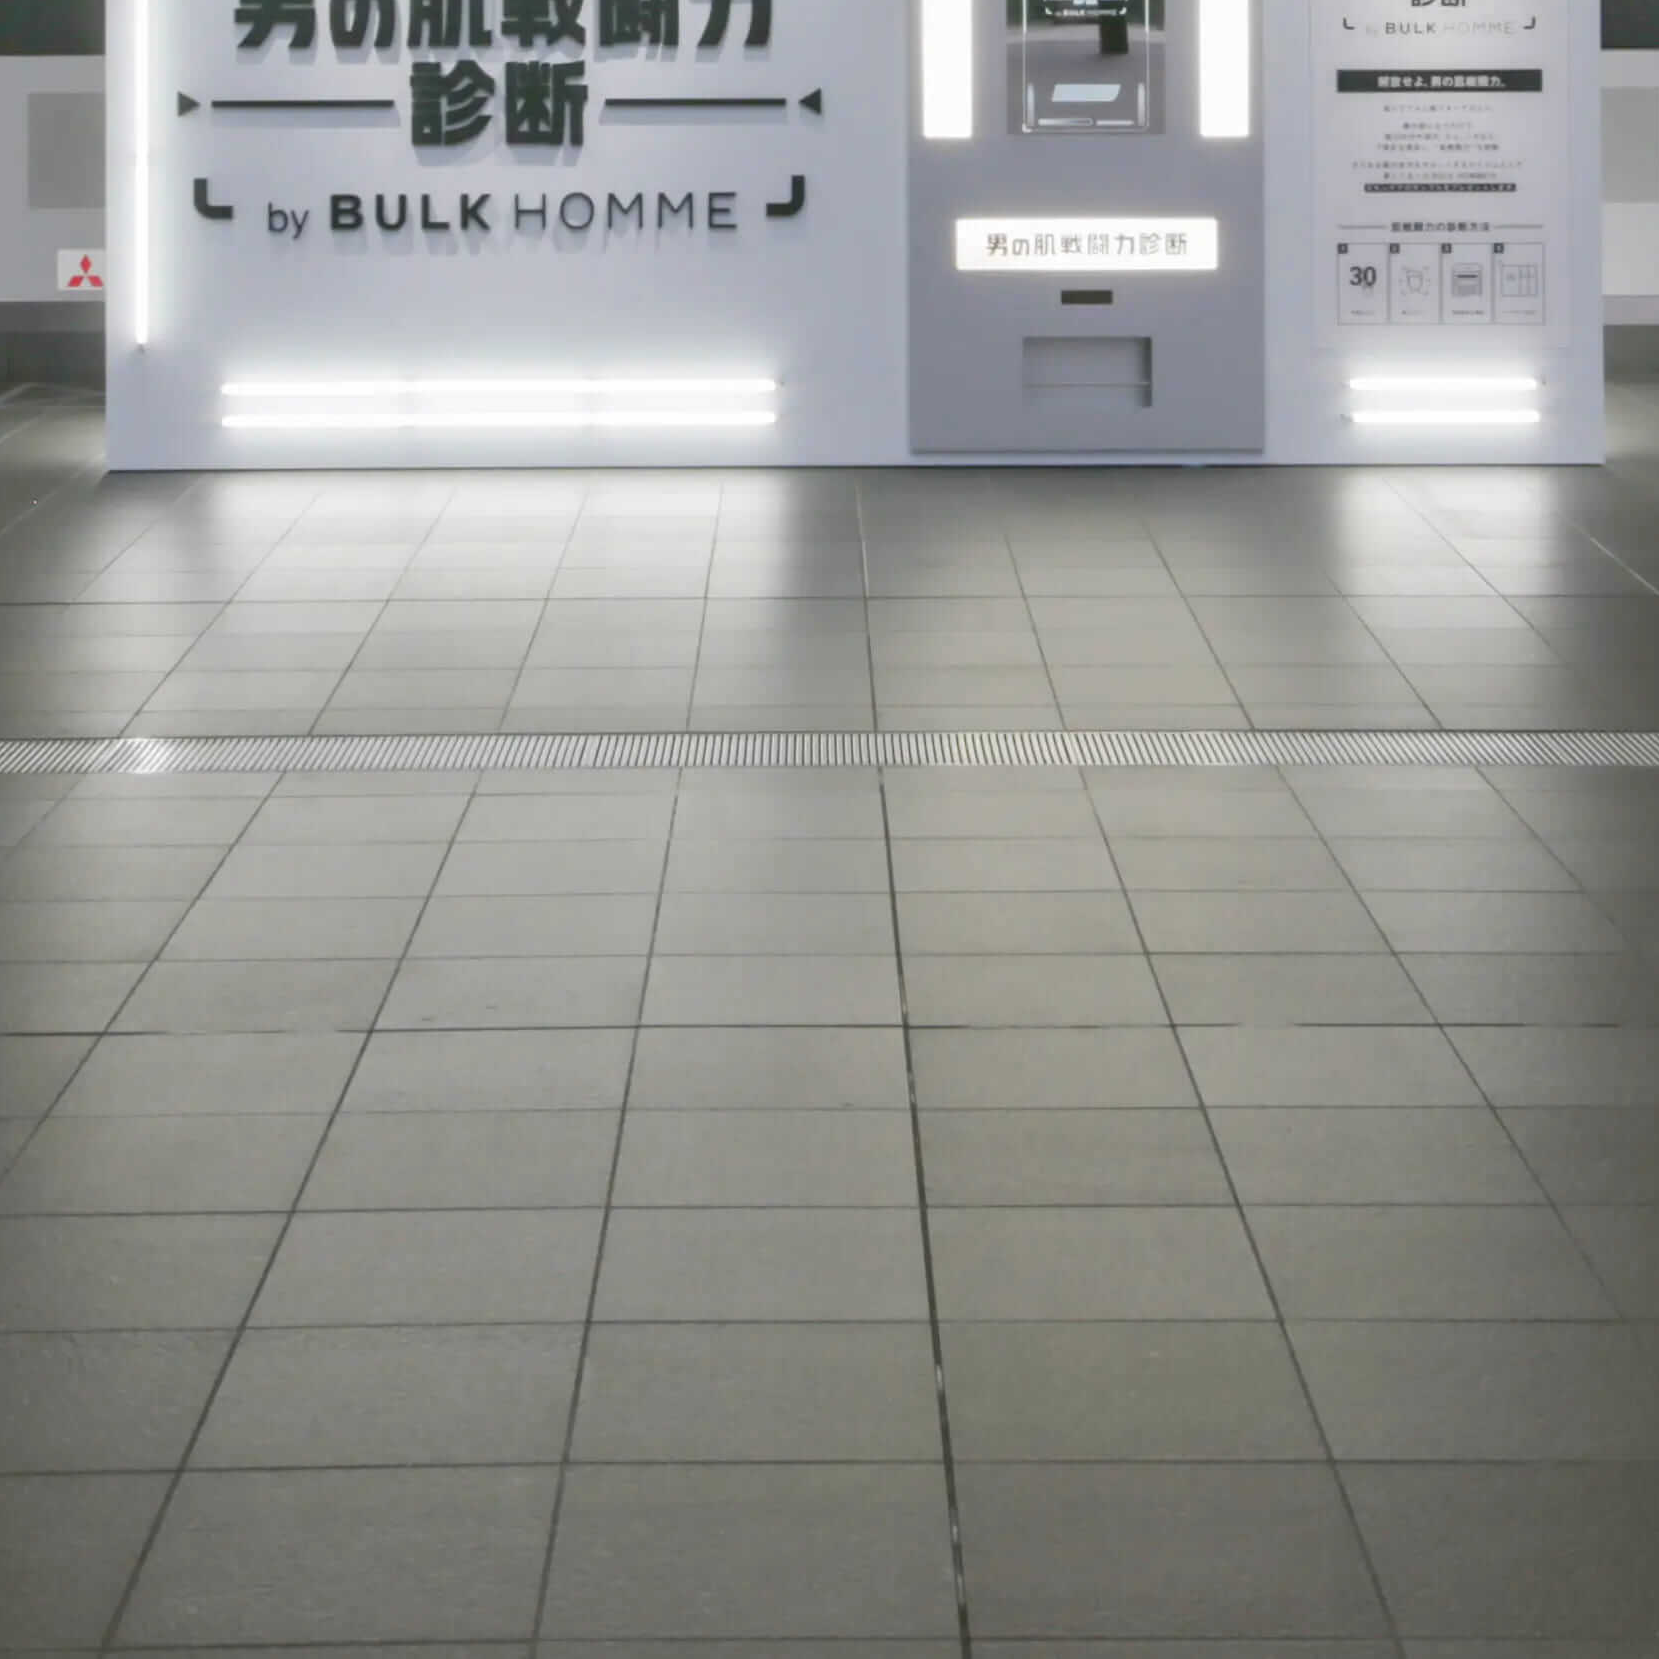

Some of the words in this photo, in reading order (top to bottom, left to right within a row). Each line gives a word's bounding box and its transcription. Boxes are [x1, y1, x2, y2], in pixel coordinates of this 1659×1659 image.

[1385, 21, 1437, 35] BULK
[410, 58, 589, 146] 診断
[266, 201, 310, 241] by
[330, 193, 491, 231] BULK
[515, 191, 739, 231] HOMME
[986, 233, 1188, 256] 男の肌戦闘力診断
[1349, 266, 1377, 287] 30
